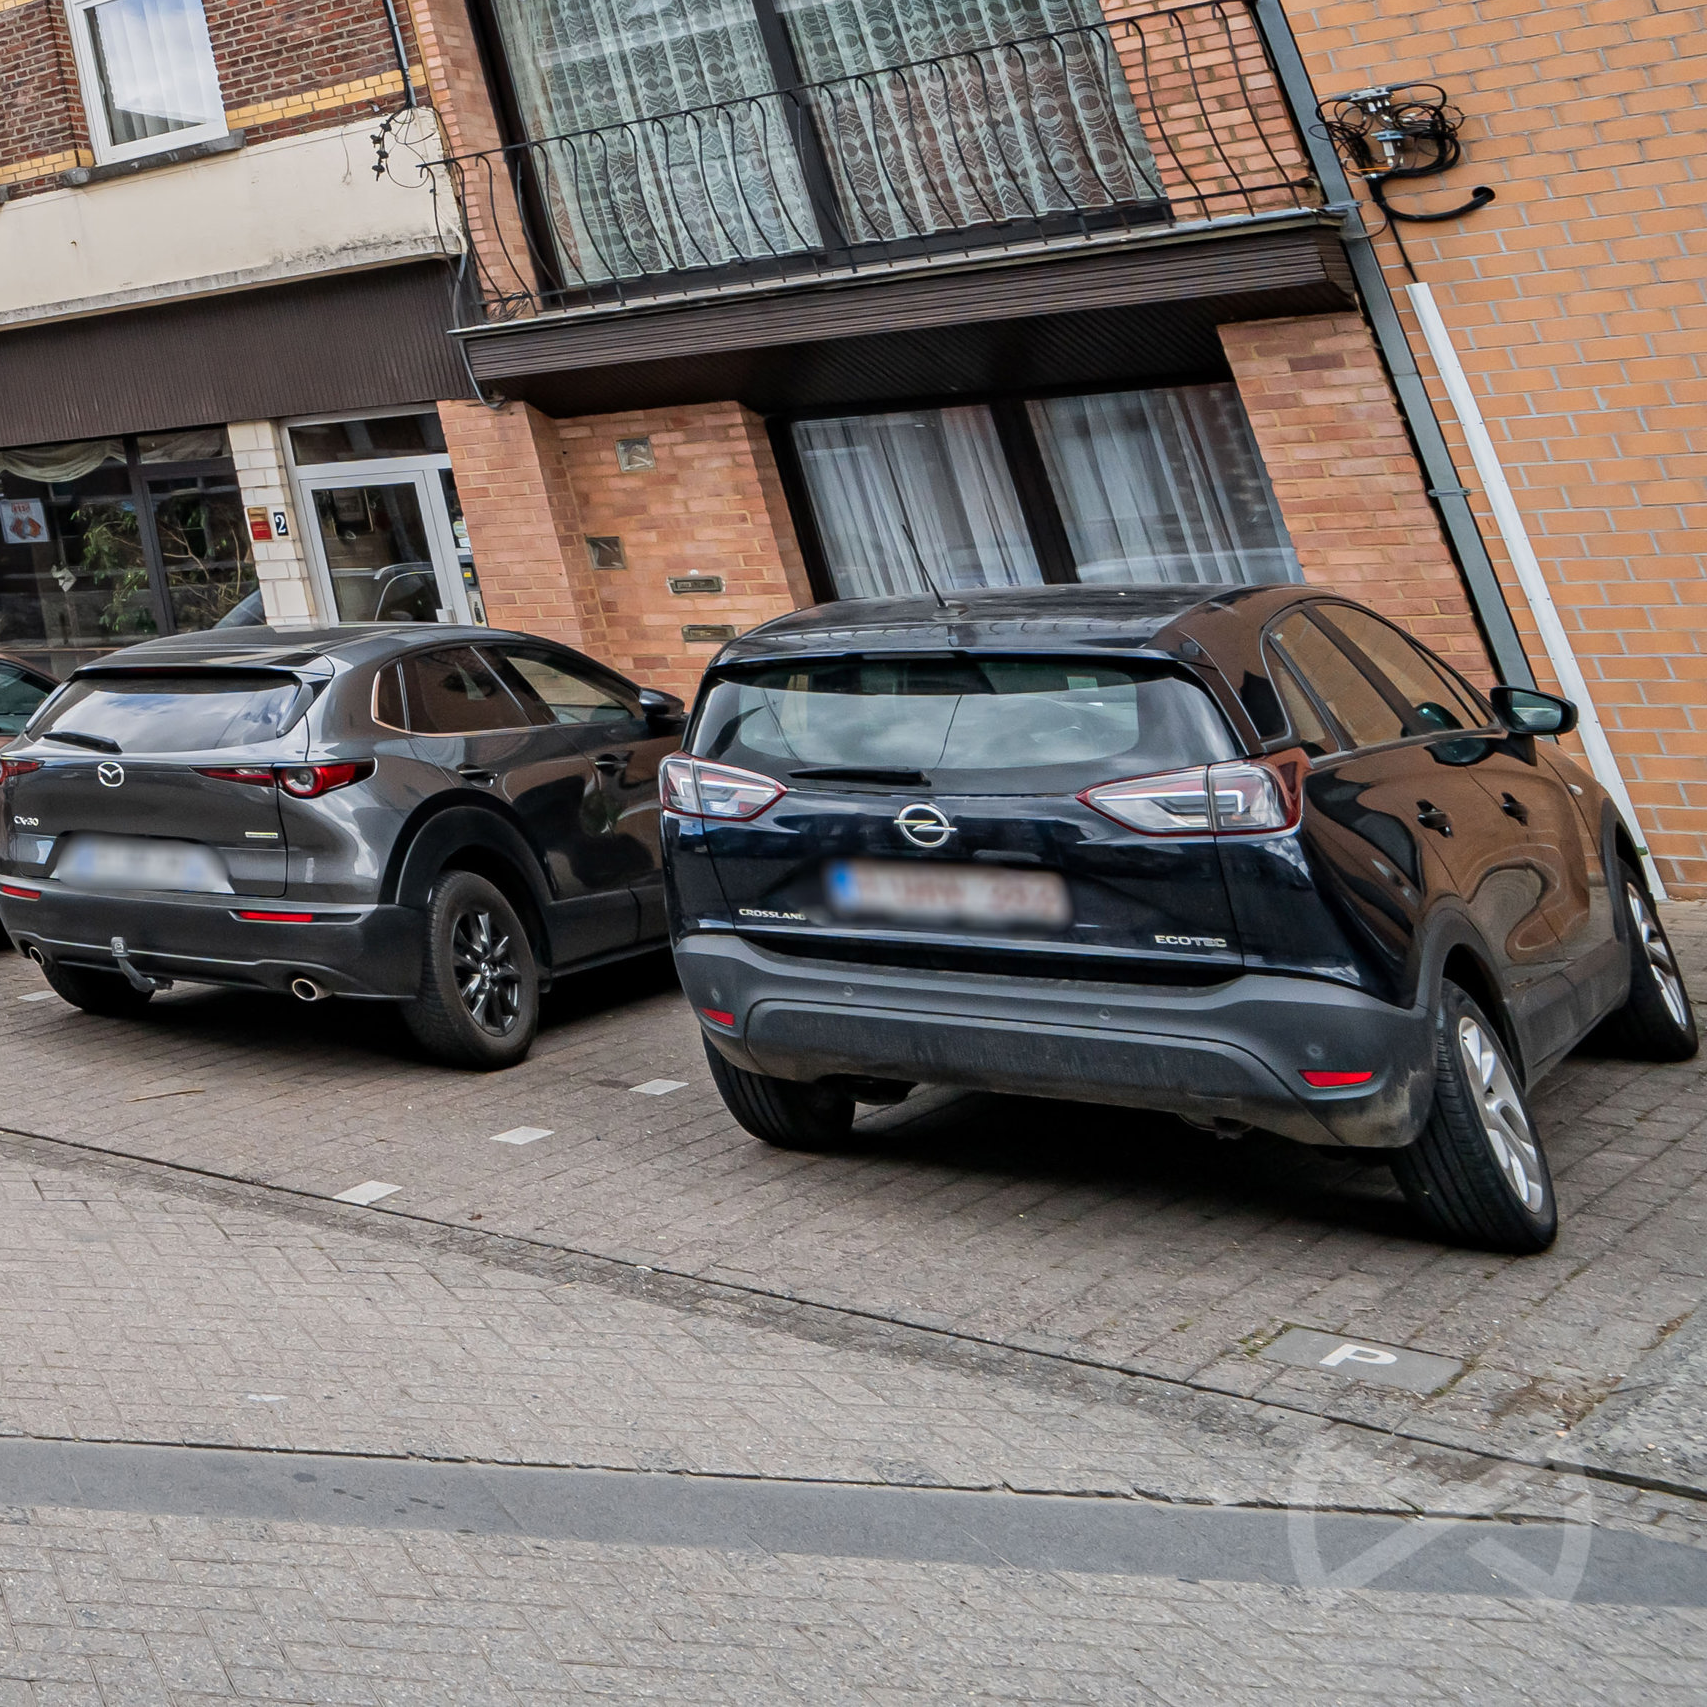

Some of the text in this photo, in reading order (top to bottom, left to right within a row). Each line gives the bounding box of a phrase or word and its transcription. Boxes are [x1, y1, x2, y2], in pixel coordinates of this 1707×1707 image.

[275, 514, 286, 533] 2
[738, 908, 807, 921] CROSSLAND
[1154, 935, 1228, 949] ECOTEC
